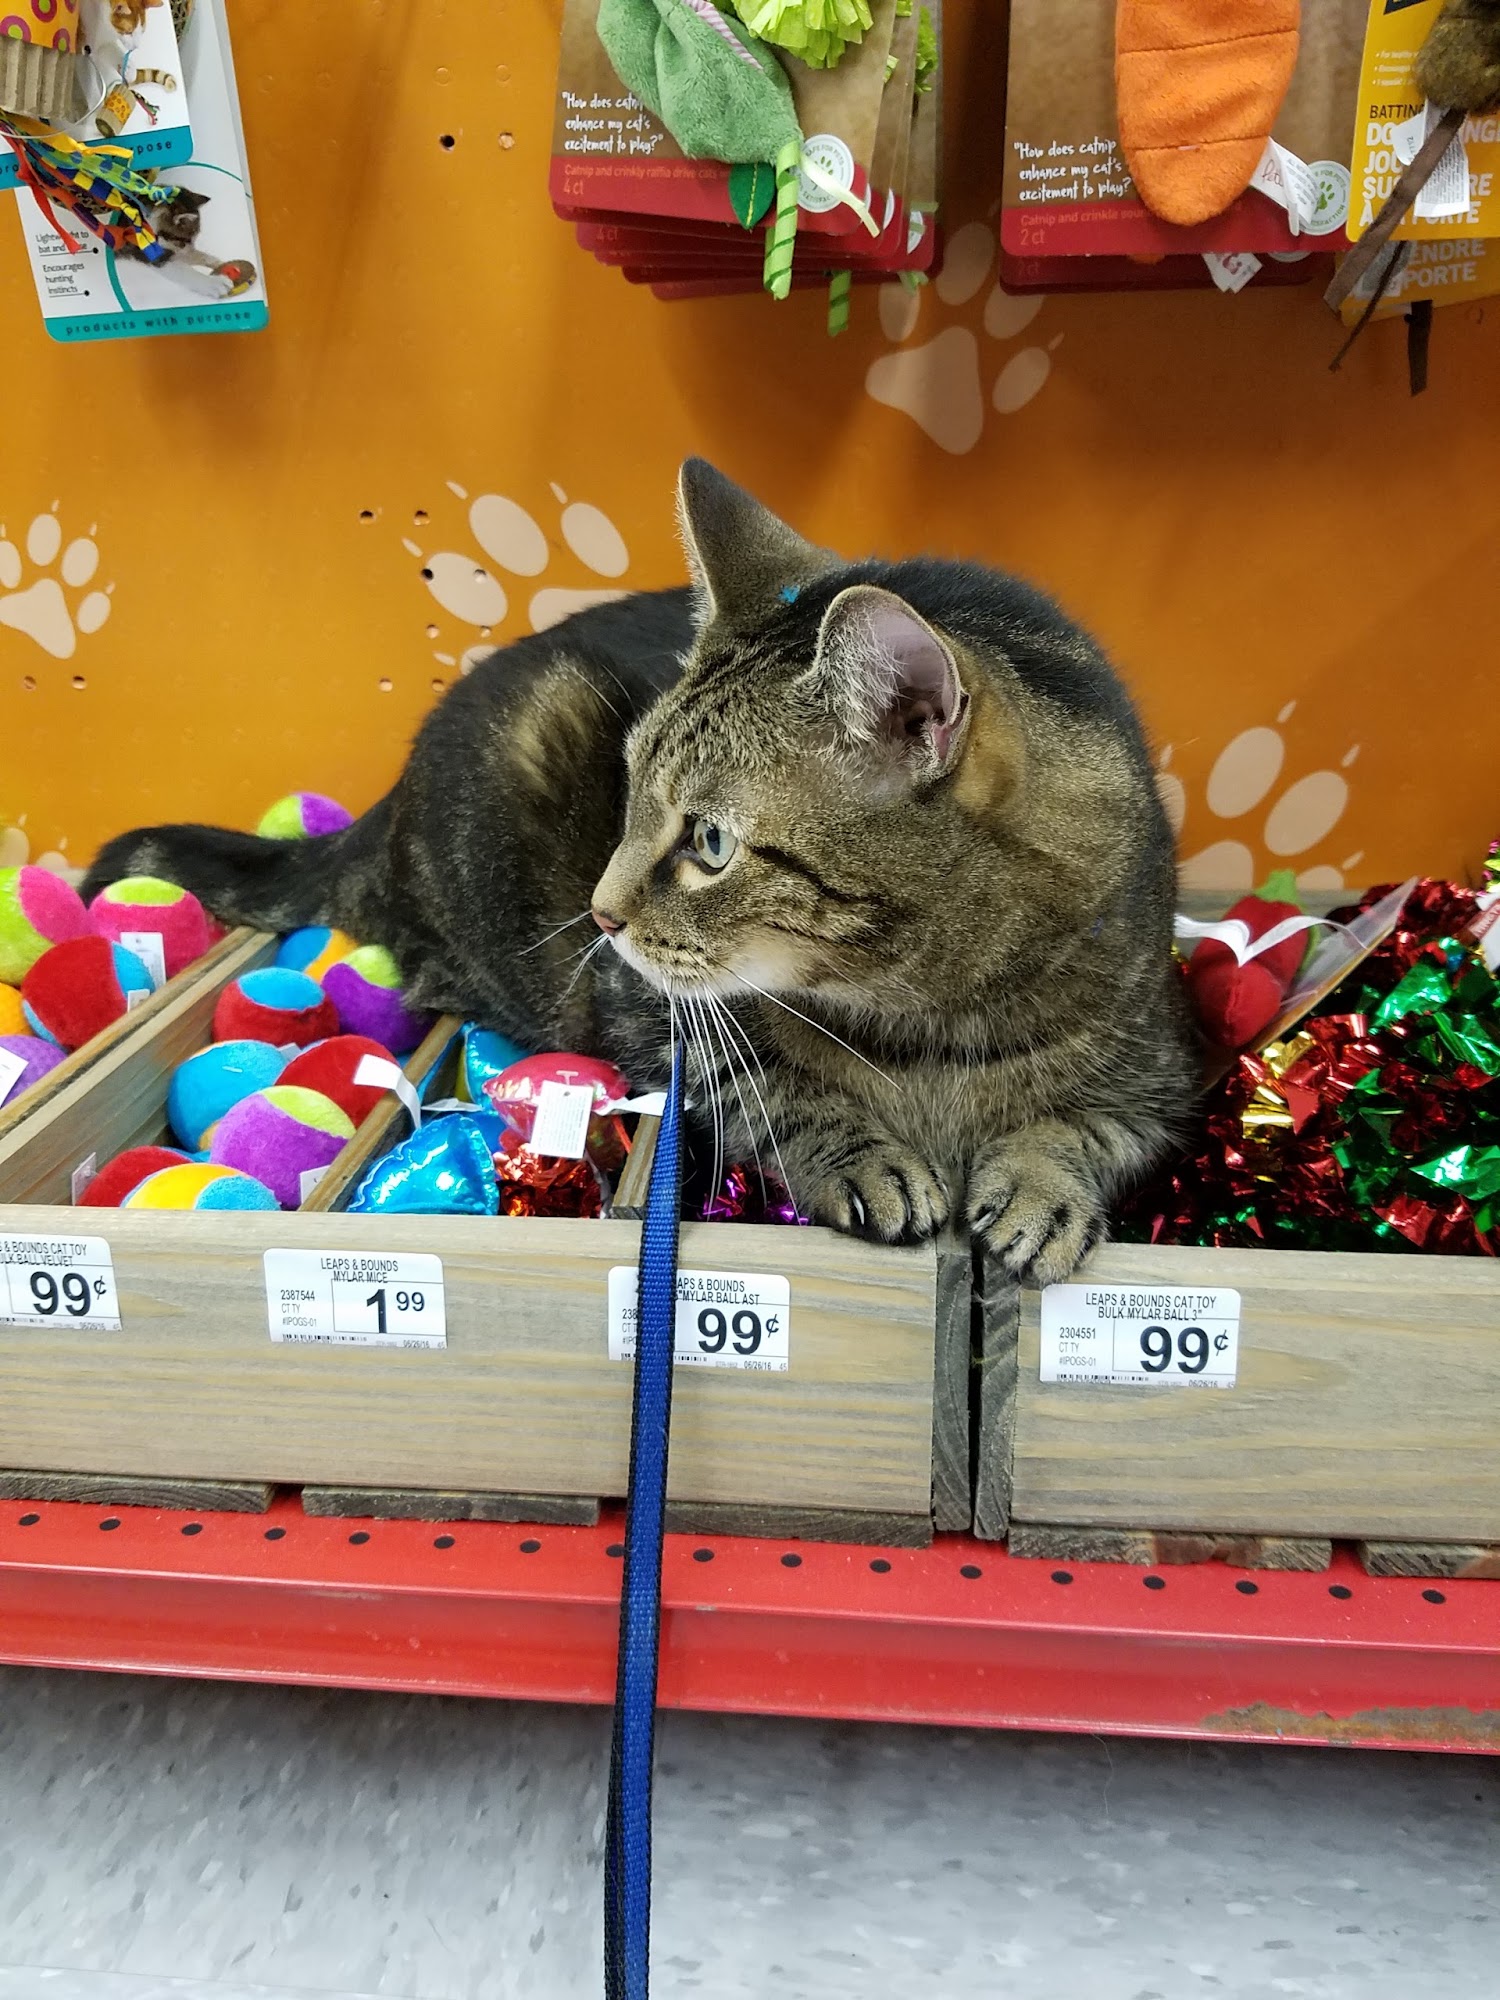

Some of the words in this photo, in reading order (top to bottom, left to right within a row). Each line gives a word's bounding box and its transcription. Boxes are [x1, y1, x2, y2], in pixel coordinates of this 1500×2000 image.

[562, 91, 587, 109] "How
[590, 93, 612, 109] does
[1369, 104, 1424, 119] BATTIN
[565, 114, 604, 131] enhance
[608, 120, 623, 133] my
[626, 114, 650, 132] cat's
[137, 141, 172, 155] pose
[564, 134, 614, 153] excitement
[617, 135, 626, 153] to
[629, 133, 664, 155] play?"
[1014, 142, 1044, 160] "How
[1048, 140, 1074, 157] does
[1079, 136, 1116, 155] catnip
[564, 164, 593, 178] Catnip
[595, 165, 612, 177] and
[614, 166, 645, 180] crinkly
[1019, 163, 1066, 181] enhance
[1071, 165, 1088, 179] my
[1093, 156, 1122, 175] cat's
[563, 179, 571, 195] 4
[573, 180, 584, 195] ct
[1019, 180, 1079, 203] excitement
[1083, 180, 1094, 198] to
[1098, 177, 1132, 199] play?
[1020, 214, 1055, 227] Catnip
[1058, 212, 1078, 224] and
[1081, 210, 1118, 222] crinkle
[1020, 229, 1028, 245] 2
[1032, 229, 1045, 245] ct
[66, 320, 136, 336] products
[145, 317, 178, 328] with
[187, 311, 251, 326] purpose
[12, 1241, 49, 1254] BOUNDS
[50, 1243, 66, 1255] CAT
[69, 1243, 87, 1256] TOY
[41, 1255, 73, 1267] VELVET
[321, 1258, 350, 1270] LEAPS
[352, 1260, 359, 1270] &
[361, 1259, 399, 1272] BOUNDS
[333, 1270, 364, 1282] MYLAR
[366, 1271, 389, 1283] MICE
[698, 1278, 704, 1289] &
[706, 1279, 745, 1293] BOUNDS
[30, 1271, 107, 1317] 99¢
[281, 1290, 315, 1301] 2387544
[716, 1292, 741, 1304] BALL
[742, 1294, 760, 1305] AST
[1085, 1293, 1117, 1306] LEAPS
[1120, 1294, 1127, 1306] &
[1129, 1294, 1171, 1308] BOUNDS
[1173, 1296, 1194, 1308] CAT
[1196, 1296, 1217, 1309] TOY
[281, 1303, 290, 1313] CT
[1098, 1306, 1124, 1319] BULK
[1127, 1307, 1161, 1320] MYLAR
[1163, 1308, 1189, 1321] BALL
[1191, 1309, 1202, 1321] 3"
[697, 1308, 779, 1355] 99¢
[1059, 1327, 1096, 1339] 2304551
[1059, 1342, 1069, 1352] CT
[1070, 1342, 1079, 1353] TY
[1139, 1325, 1229, 1374] 99¢
[744, 1361, 771, 1370] 06/26/16
